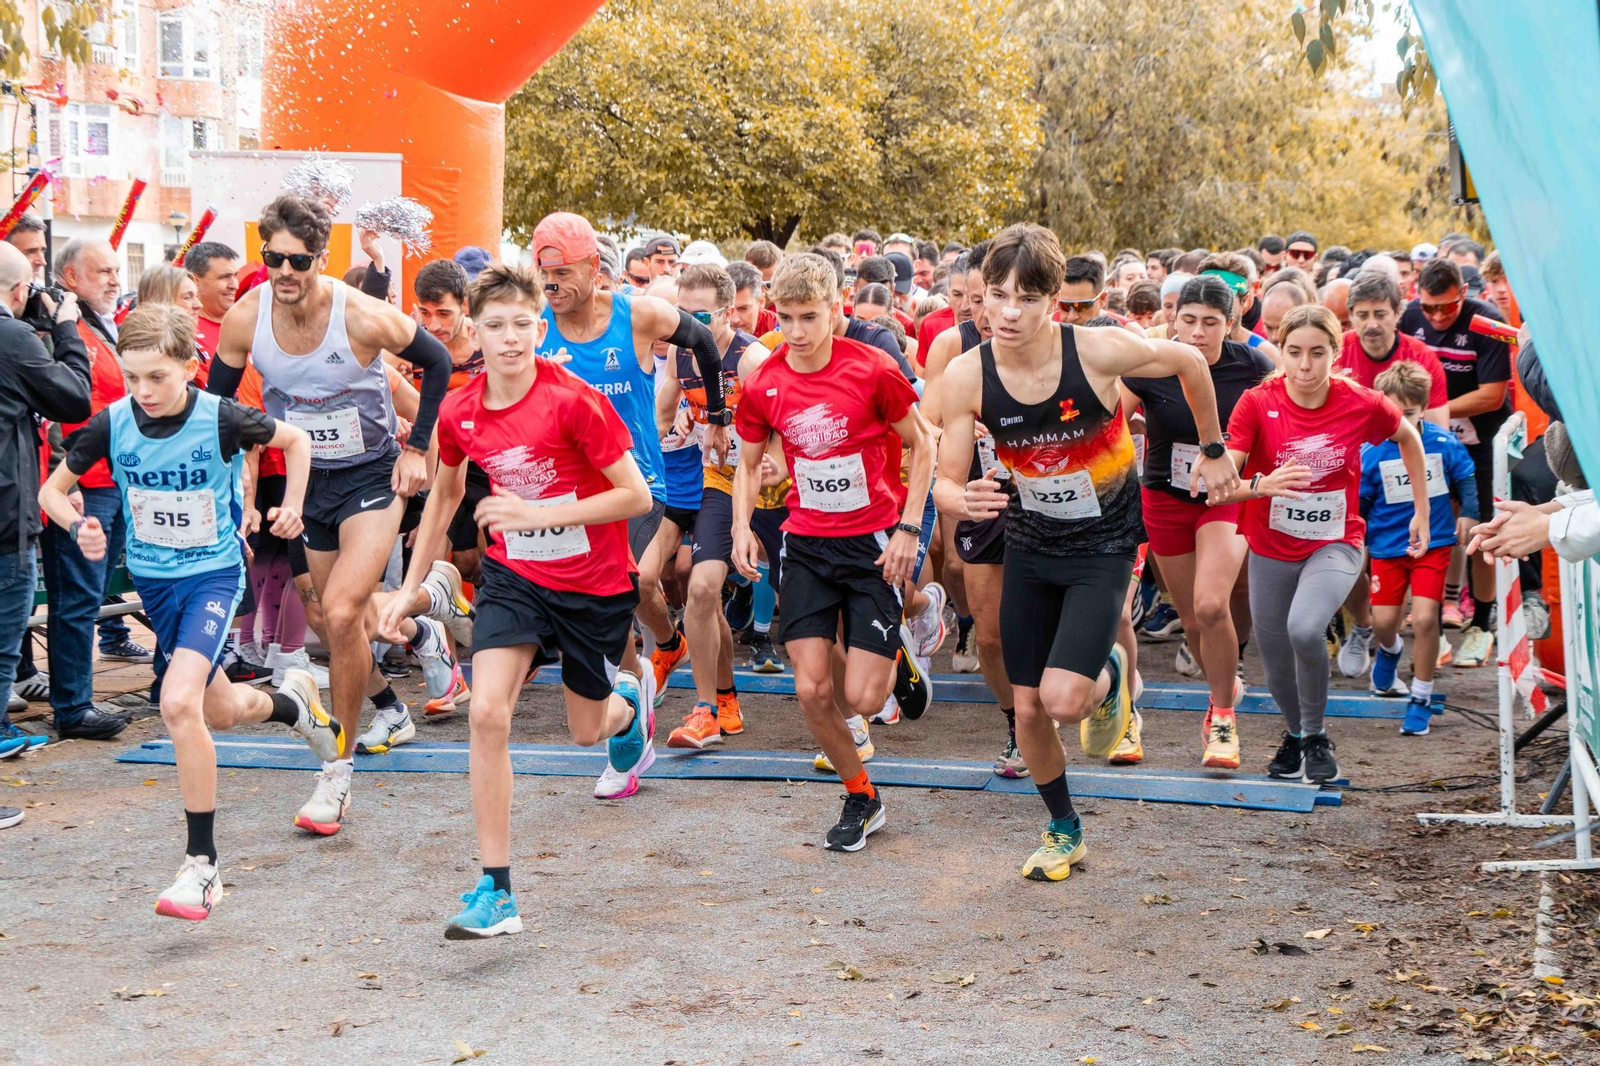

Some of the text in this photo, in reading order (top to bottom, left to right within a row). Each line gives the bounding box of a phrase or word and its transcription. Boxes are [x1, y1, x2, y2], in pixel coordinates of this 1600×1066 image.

[717, 370, 725, 399] KIPRUN
[1007, 428, 1085, 448] HAMMAM
[123, 463, 208, 492] nerja
[807, 477, 851, 493] 1369
[1028, 488, 1078, 504] 1232
[153, 511, 191, 527] 515
[1286, 507, 1332, 523] 1368
